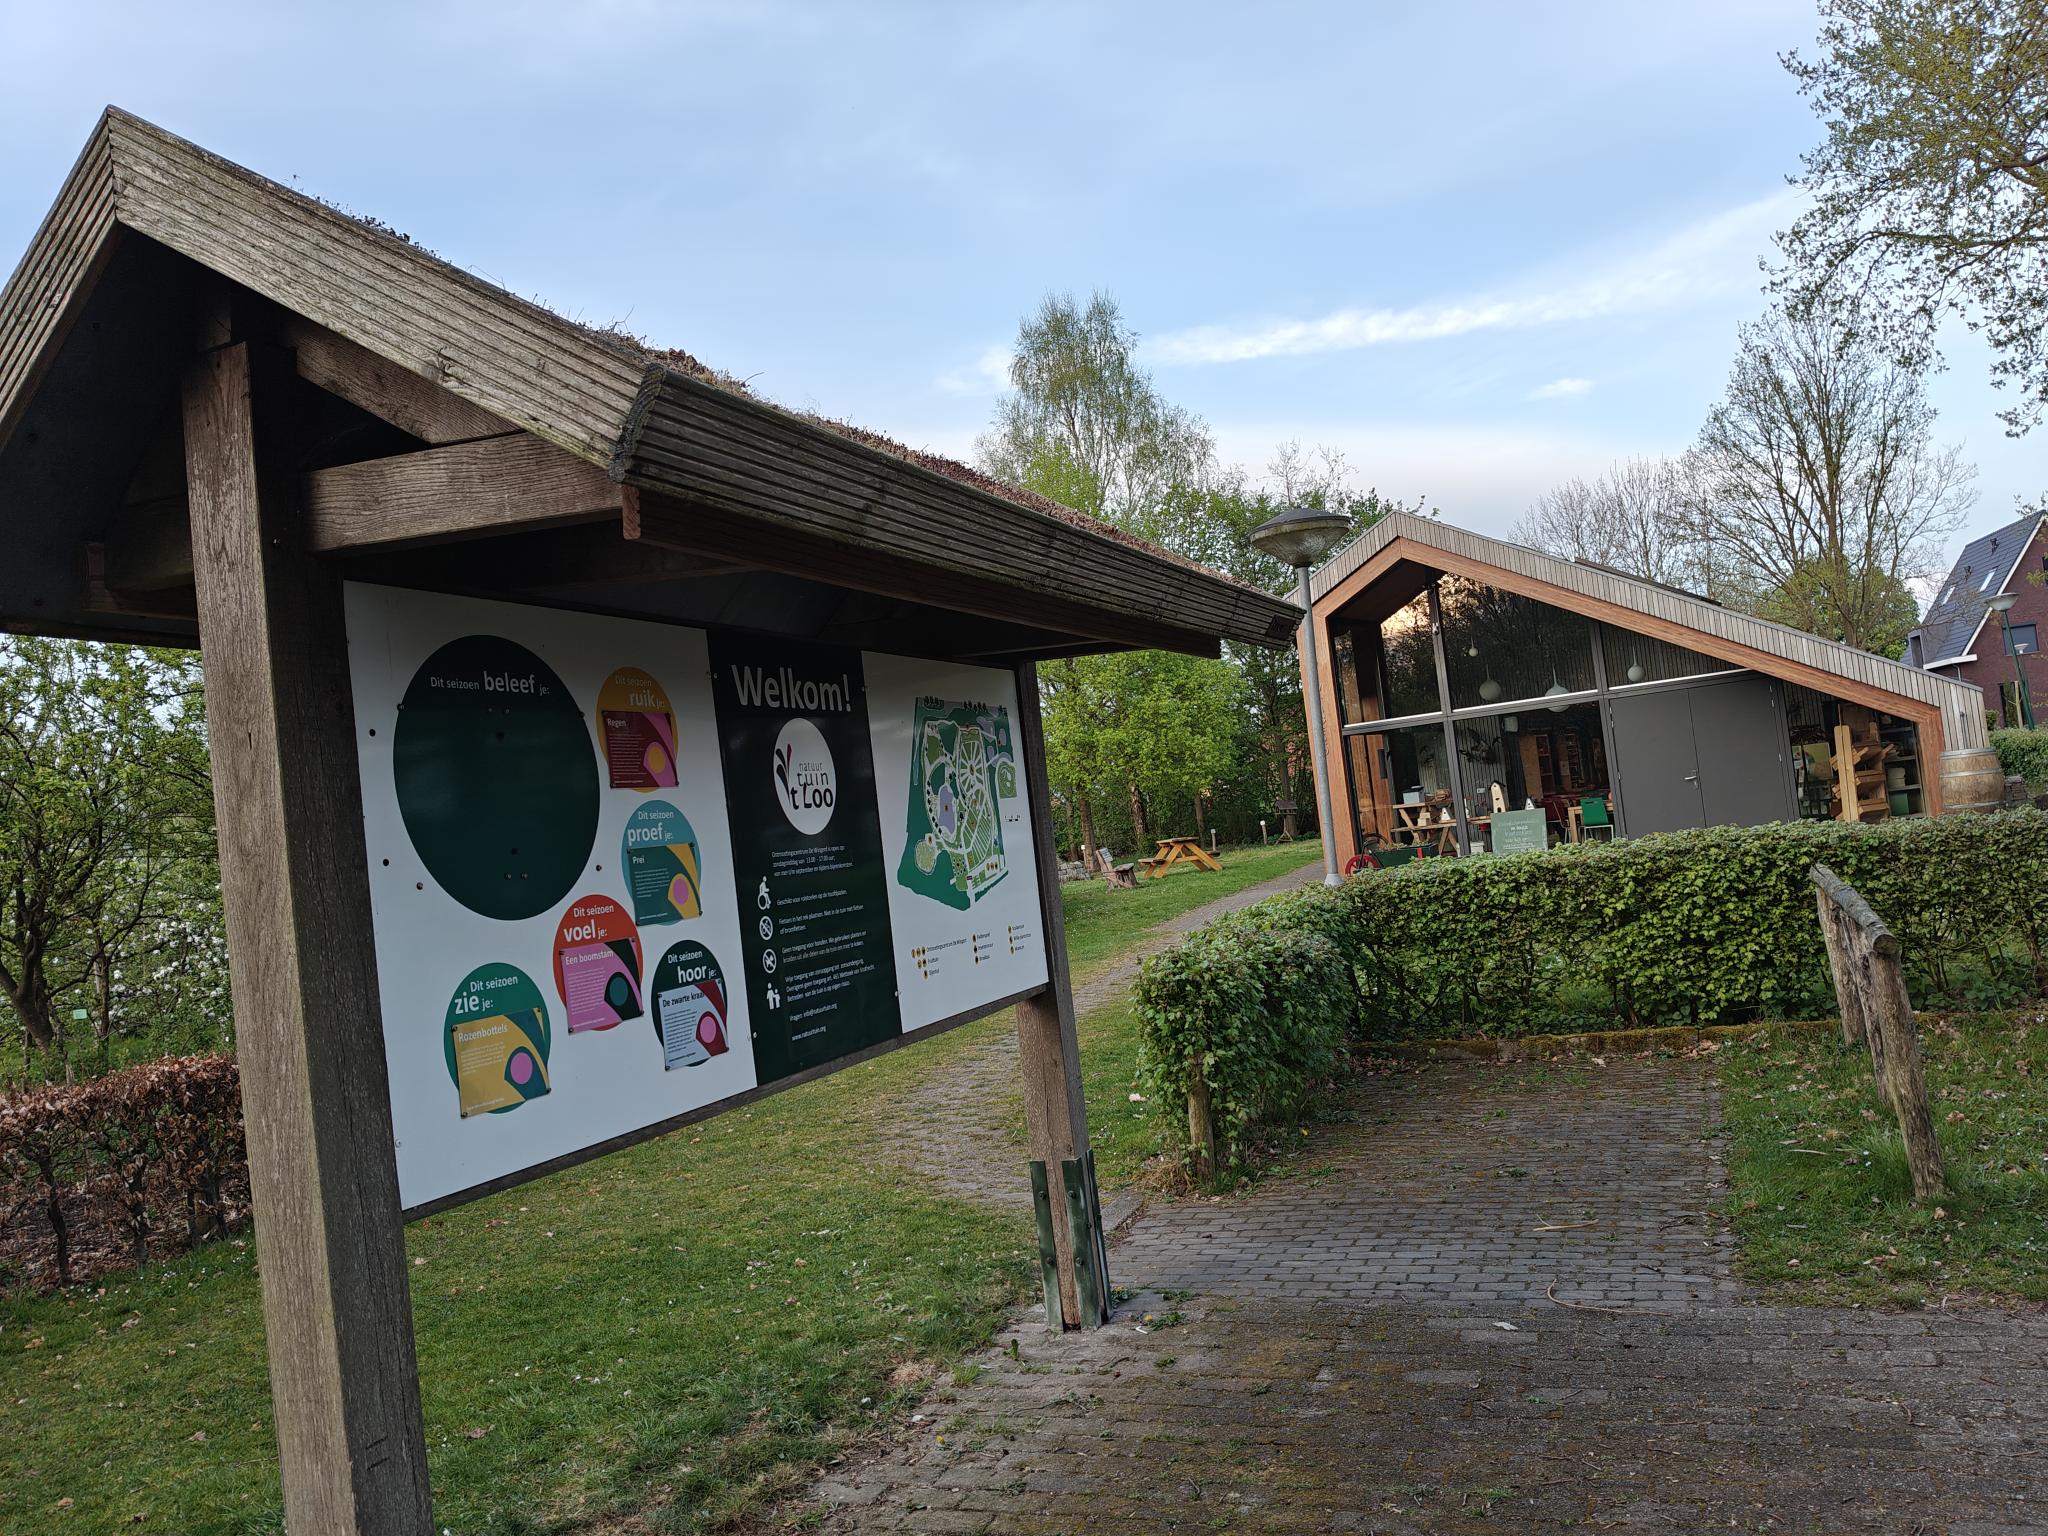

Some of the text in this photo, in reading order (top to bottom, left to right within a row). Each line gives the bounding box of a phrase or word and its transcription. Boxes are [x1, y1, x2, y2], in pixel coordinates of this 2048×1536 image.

[430, 670, 551, 696] Dit seizoen beleef je:
[615, 674, 626, 686] Dit
[731, 664, 851, 712] Welkom!
[629, 690, 655, 708] ruik
[799, 762, 823, 772] natuur
[797, 771, 829, 786] tuin
[803, 782, 834, 808] Loo
[638, 810, 674, 820] Dit seizoen
[627, 822, 673, 846] proef je:
[632, 855, 645, 865] Prei
[573, 905, 614, 918] Dit seizoen
[563, 919, 608, 943] voel je:
[565, 950, 614, 966] Een boomstam
[668, 951, 703, 964] Dit seizoen
[677, 966, 717, 984] hoor je:
[471, 976, 518, 993] Dit seizoen
[454, 992, 494, 1014] zie je:
[663, 998, 671, 1008] De
[672, 995, 690, 1005] zwarte
[459, 1024, 508, 1042] Rozenbottels
